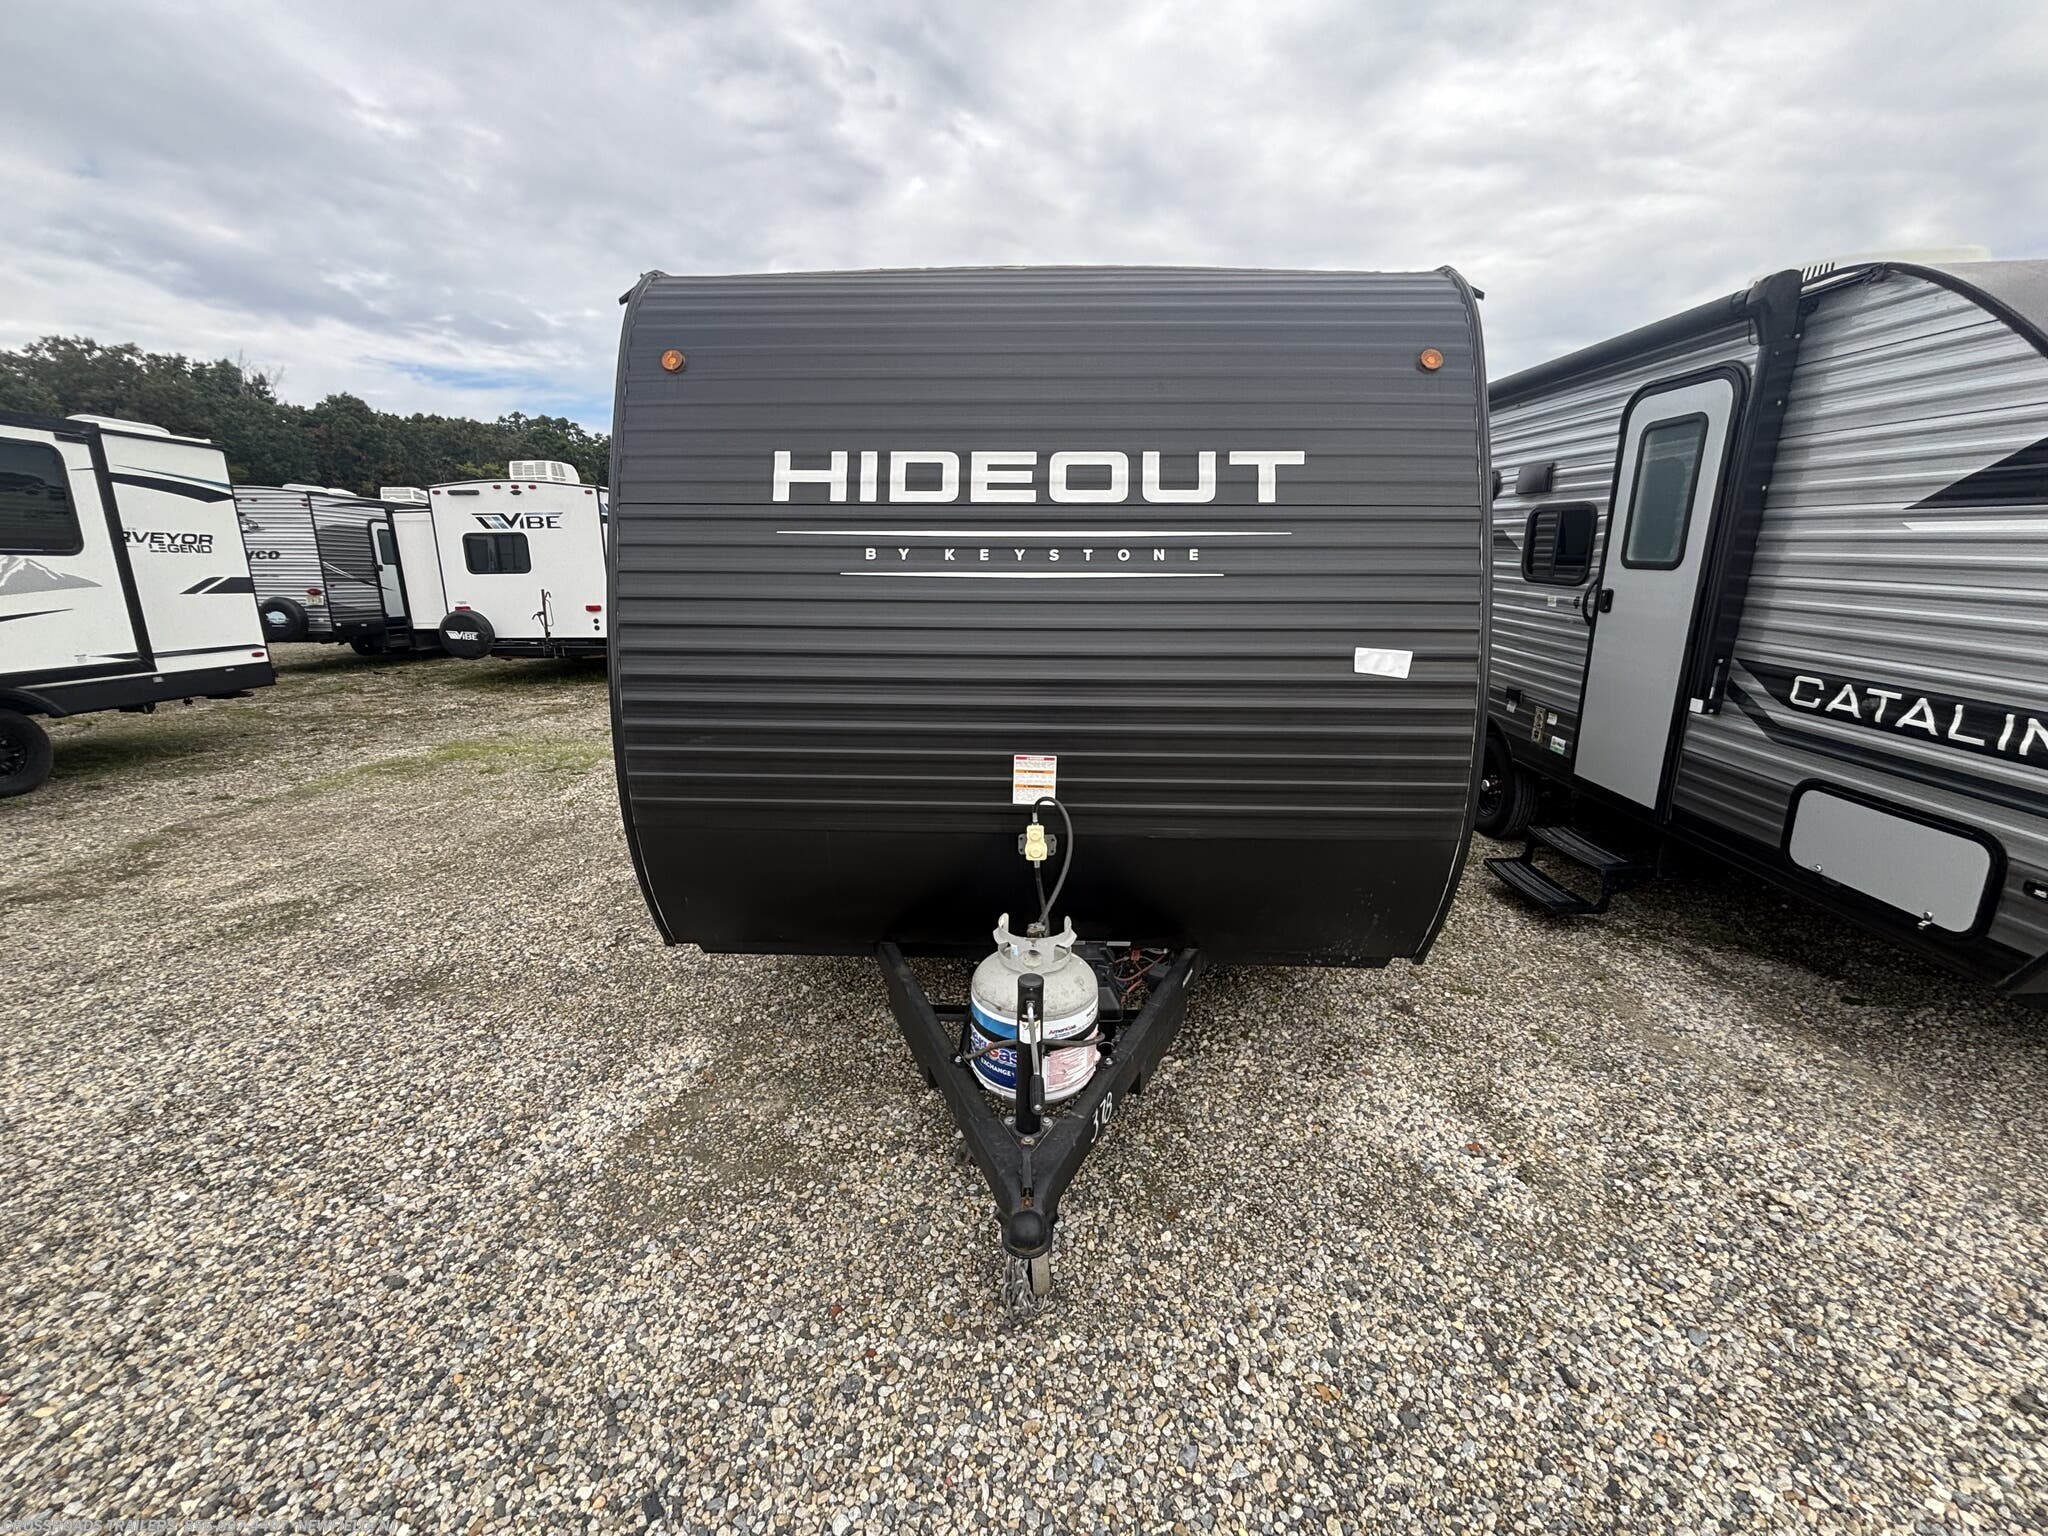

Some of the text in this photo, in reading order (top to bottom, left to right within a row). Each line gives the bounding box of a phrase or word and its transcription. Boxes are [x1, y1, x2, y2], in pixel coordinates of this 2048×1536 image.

[772, 450, 1306, 504] HIDEOUT
[471, 511, 564, 530] VIBE
[148, 543, 213, 554] LEGEND
[865, 548, 1200, 562] BY KEYSTONE
[445, 630, 479, 641] VIBE
